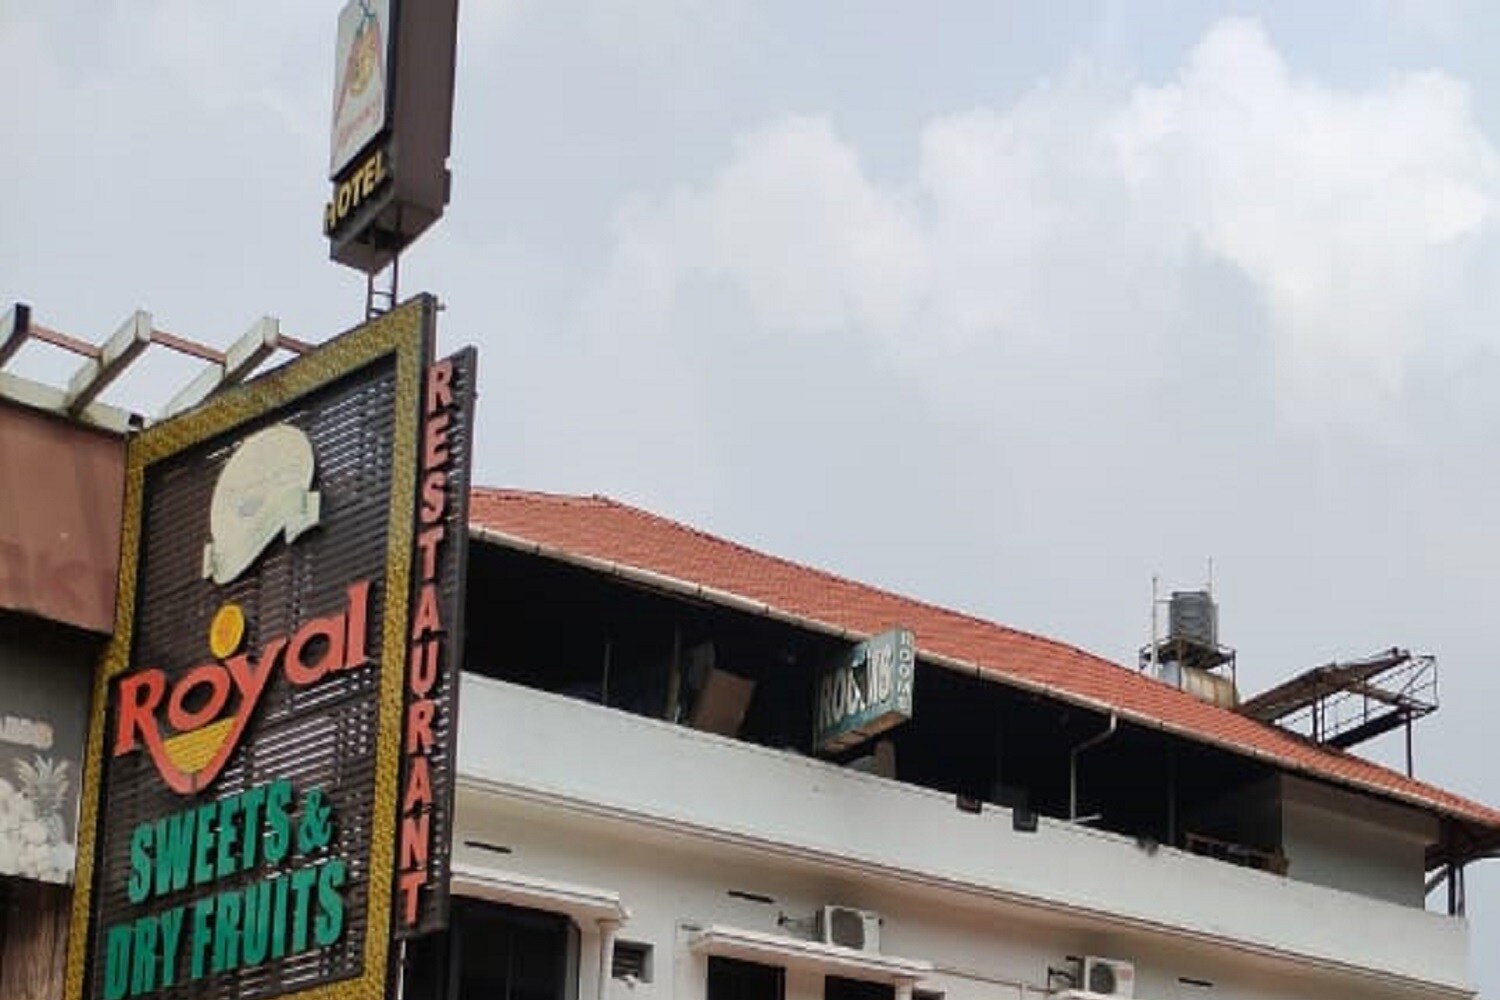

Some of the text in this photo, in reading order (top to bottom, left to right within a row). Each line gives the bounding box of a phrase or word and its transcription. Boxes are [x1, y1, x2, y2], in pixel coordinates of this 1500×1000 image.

[114, 580, 370, 795] Royal
[400, 360, 454, 925] RESTAURANT
[128, 778, 333, 904] SWEETS &
[191, 857, 347, 982] FRUITS
